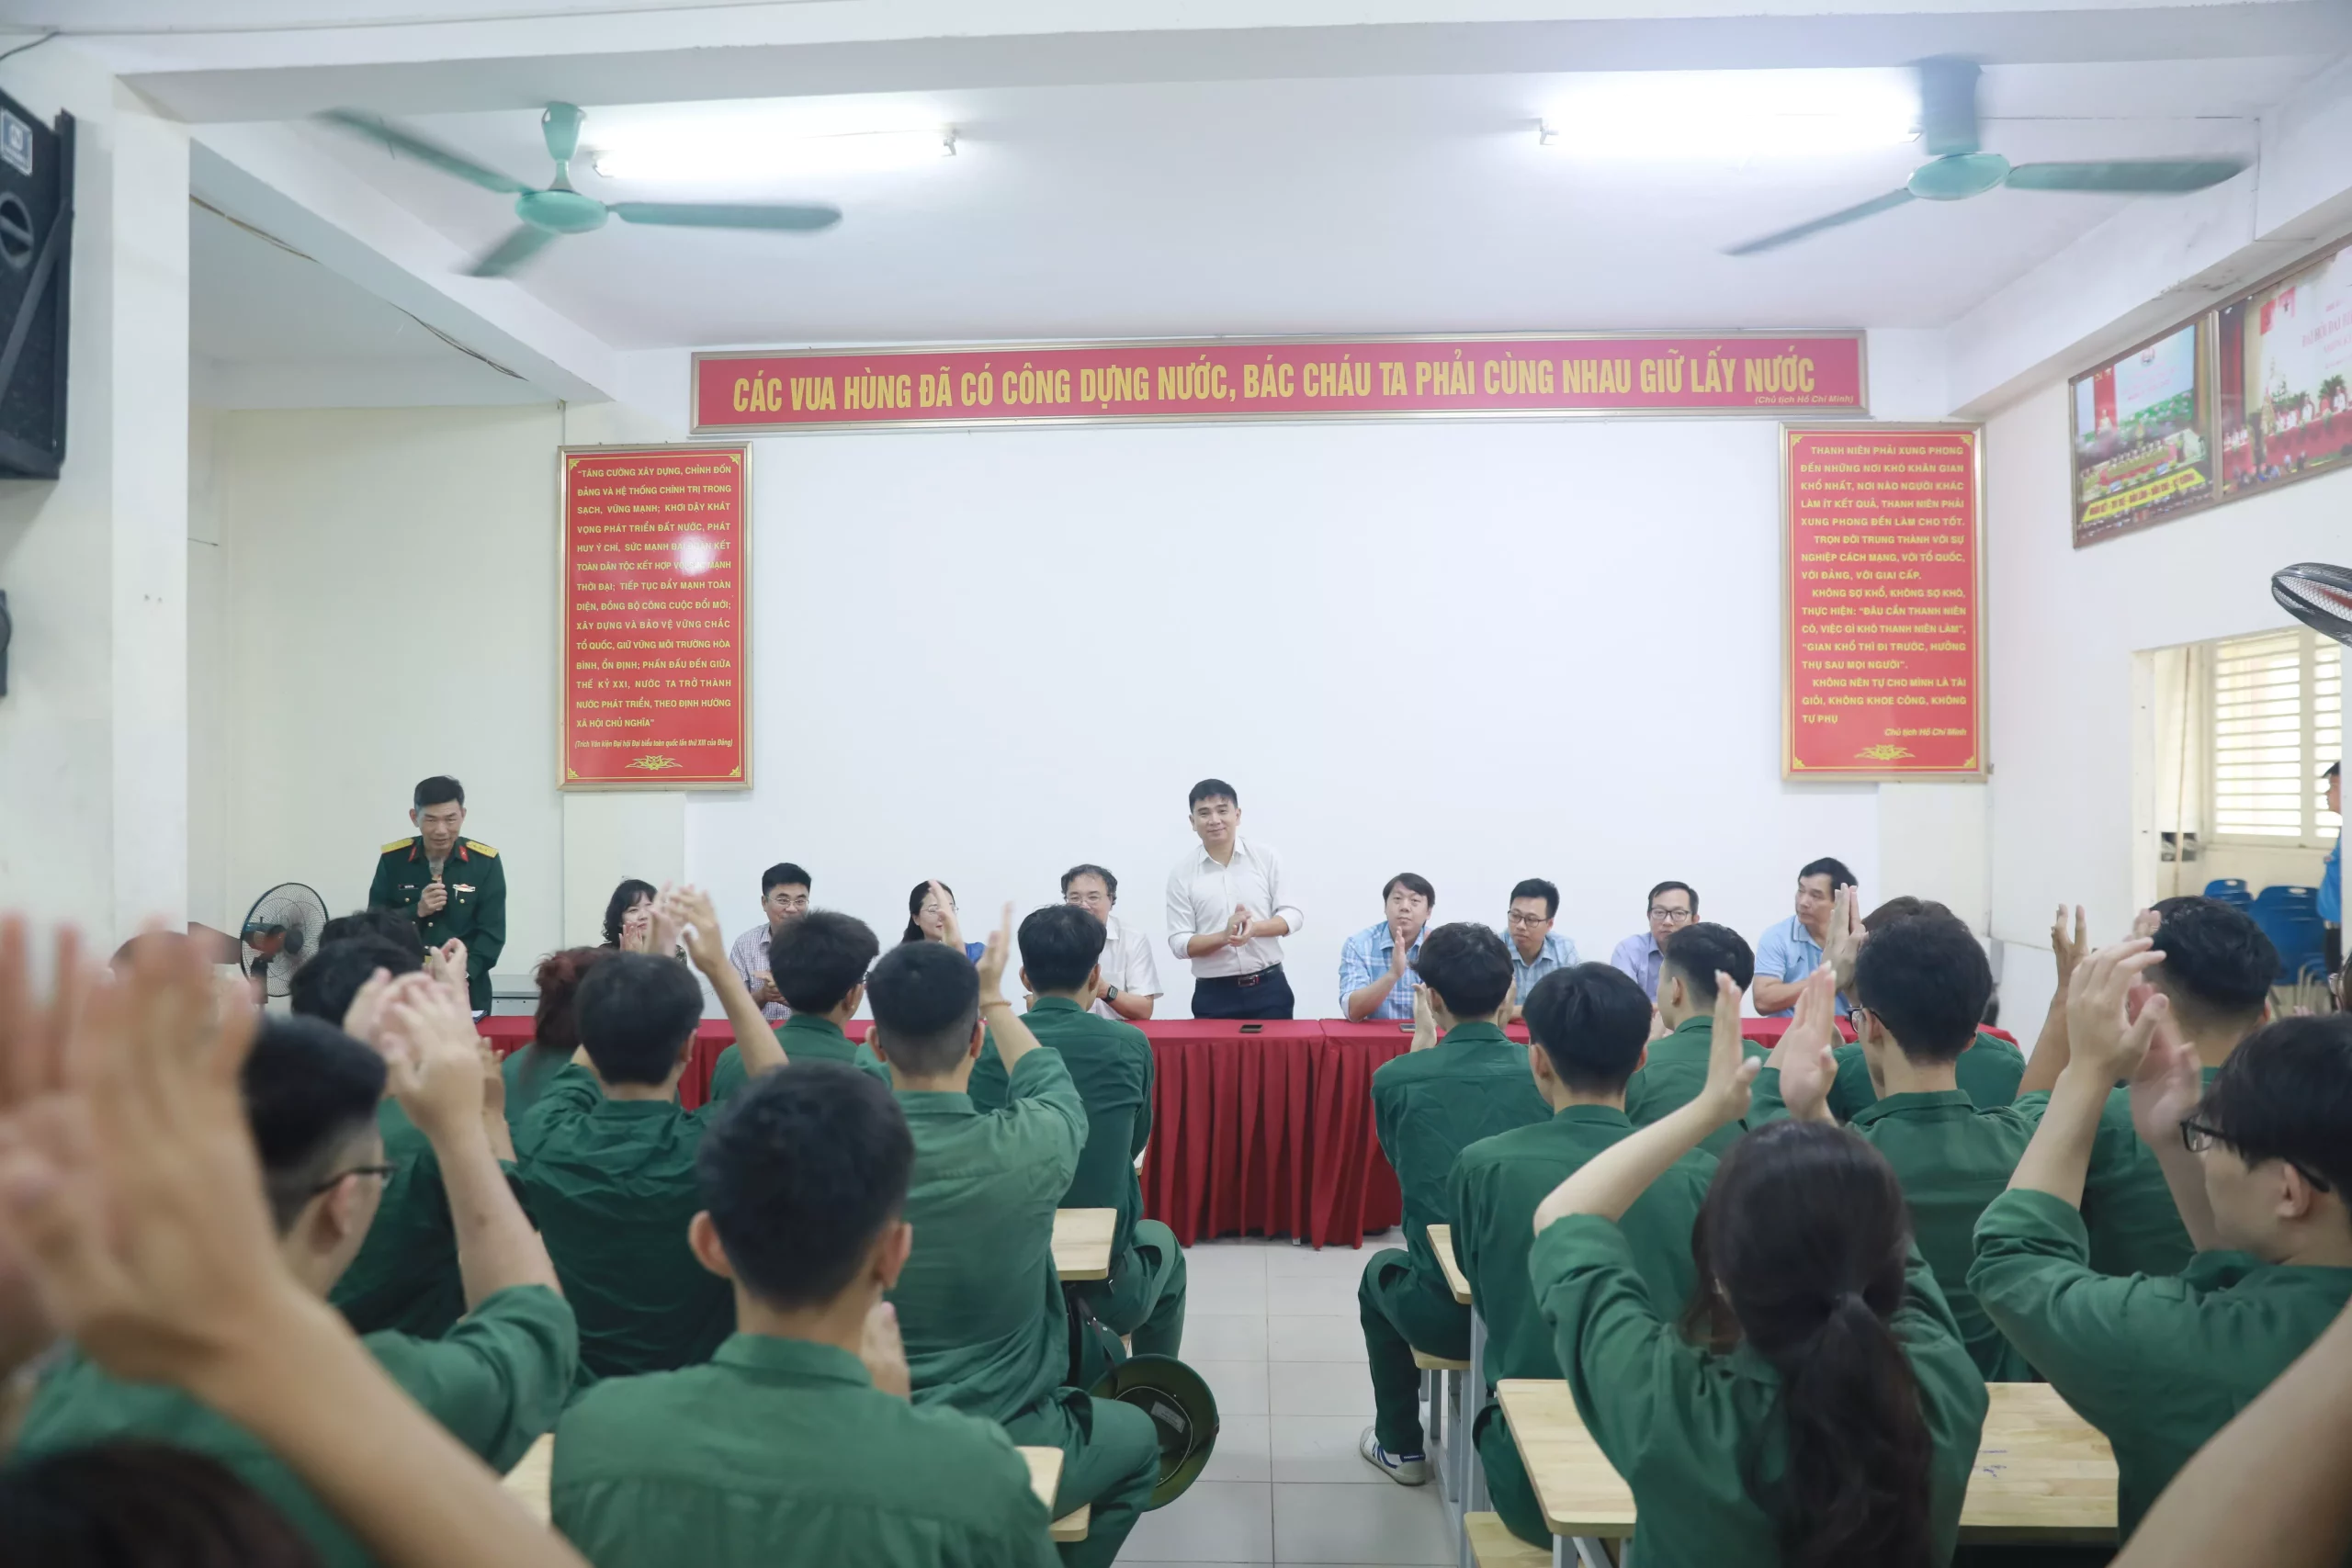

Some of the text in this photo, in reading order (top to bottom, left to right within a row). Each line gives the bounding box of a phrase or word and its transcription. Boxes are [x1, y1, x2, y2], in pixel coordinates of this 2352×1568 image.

[734, 345, 1815, 412] CÁC VUA HÙNG ĐÃ CÓ CÔNG DỰNG NƯỚC, BÁC CHÁU TA PHẢI CÙNG NHAU GIỮ LẤY NƯỚC
[1811, 445, 1963, 455] THANH NIÊN PHẢI XUNG PHONG
[606, 468, 636, 477] CƯỜNG
[639, 467, 654, 476] XÂY
[685, 464, 711, 474] CHỈNH
[713, 463, 731, 474] ĐỐN
[1800, 461, 1822, 472] ĐẾN
[1863, 464, 1881, 472] NƠI
[578, 487, 600, 496] ĐẢNG
[603, 487, 614, 495] VÀ
[616, 486, 627, 496] HỆ
[629, 485, 657, 494] THỐNG
[660, 485, 685, 494] CHÍNH
[687, 486, 700, 494] TRỊ
[1801, 479, 1823, 491] KHỔ
[1857, 481, 1875, 491] NƠI
[1877, 481, 1899, 490] NÀO
[607, 504, 630, 513] VỮNG
[665, 503, 685, 512] KHƠI
[687, 502, 705, 512] DẬY
[707, 502, 730, 511] KHÁT
[1871, 515, 1892, 525] ĐẾN
[577, 525, 602, 535] VỌNG
[604, 524, 627, 533] PHÁT
[629, 521, 655, 532] TRIỂN
[658, 521, 675, 532] ĐẤT
[707, 521, 730, 531] PHÁT
[596, 542, 602, 552] Ý
[625, 542, 642, 551] SỨC
[644, 543, 669, 553] MẠNH
[1801, 570, 1819, 580] VỚI
[1856, 570, 1872, 580] VỚI
[1875, 571, 1896, 580] GIAI
[577, 581, 596, 591] THỜI
[620, 581, 639, 590] TIẾP
[641, 582, 658, 591] TỤC
[661, 581, 678, 589] ĐẨY
[681, 581, 706, 590] MẠNH
[707, 579, 731, 589] TOÀN
[601, 601, 625, 610] ĐỒNG
[628, 601, 640, 611] BỘ
[641, 601, 666, 610] CÔNG
[669, 600, 693, 610] CUỘC
[695, 599, 710, 609] ĐỔI
[1802, 606, 1827, 616] THỰC
[1885, 604, 1905, 615] CẦN
[1943, 606, 1966, 615] NIÊN
[576, 639, 587, 649] TỔ
[617, 640, 631, 649] GIỮ
[633, 640, 656, 649] VỮNG
[659, 639, 673, 649] MÔI
[675, 639, 711, 648] TRƯỜNG
[713, 638, 730, 648] HÒA
[1834, 639, 1856, 651] KHỔ
[1858, 642, 1875, 650] THÌ
[1877, 643, 1888, 651] ĐI
[602, 659, 614, 669] ỔN
[643, 659, 666, 668] PHẤN
[669, 659, 686, 668] ĐẤU
[689, 658, 707, 668] ĐẾN
[710, 659, 731, 668] GIỮA
[1825, 660, 1845, 670] SAU
[576, 700, 599, 708] NƯỚC
[602, 699, 623, 708] PHÁT
[679, 700, 699, 708] ĐỊNH
[701, 698, 731, 706] HƯỚNG
[576, 718, 588, 728] XÃ
[589, 718, 604, 728] HỘI
[605, 716, 623, 728] CHỦ
